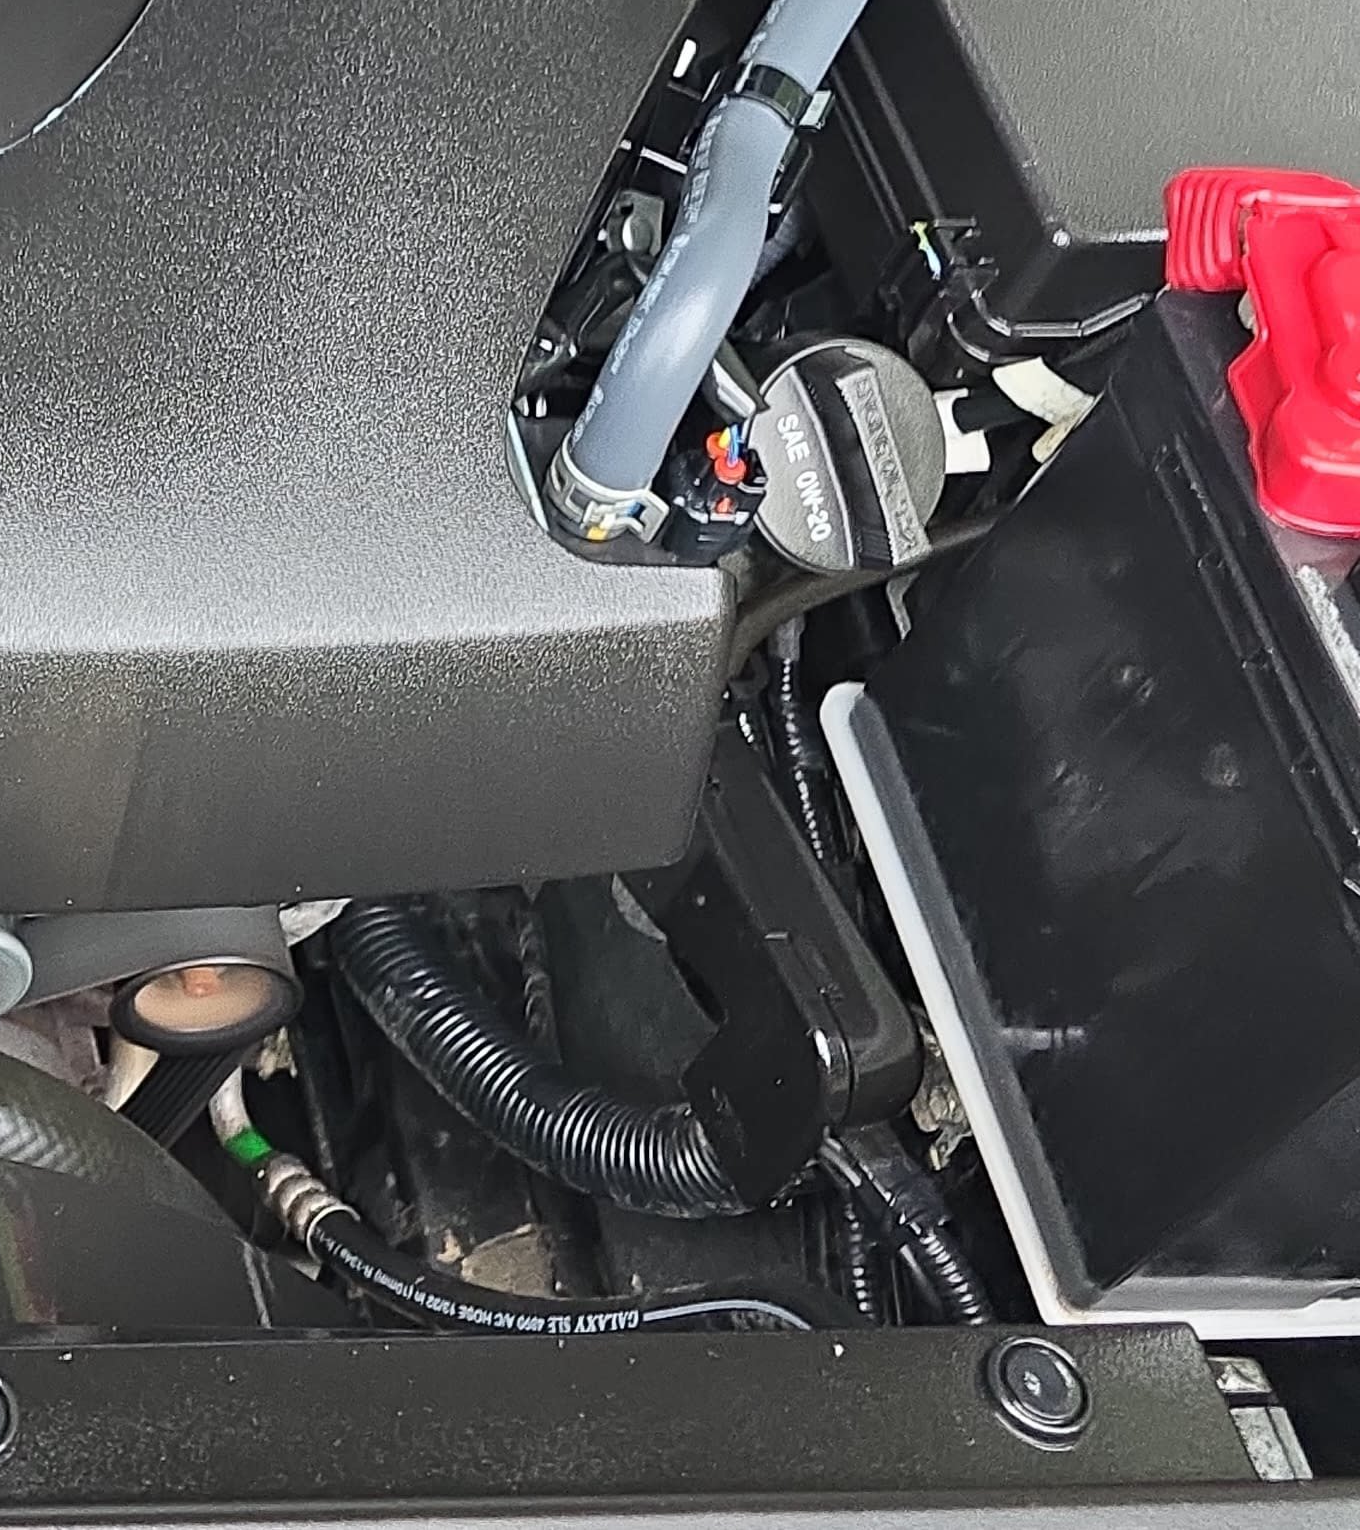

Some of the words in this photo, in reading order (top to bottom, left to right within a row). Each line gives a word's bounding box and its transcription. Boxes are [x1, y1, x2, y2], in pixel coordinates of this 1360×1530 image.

[775, 412, 810, 464] SAE
[794, 472, 833, 544] 0W-20
[457, 1305, 492, 1325] HOSE
[574, 1310, 639, 1333] GALAXY
